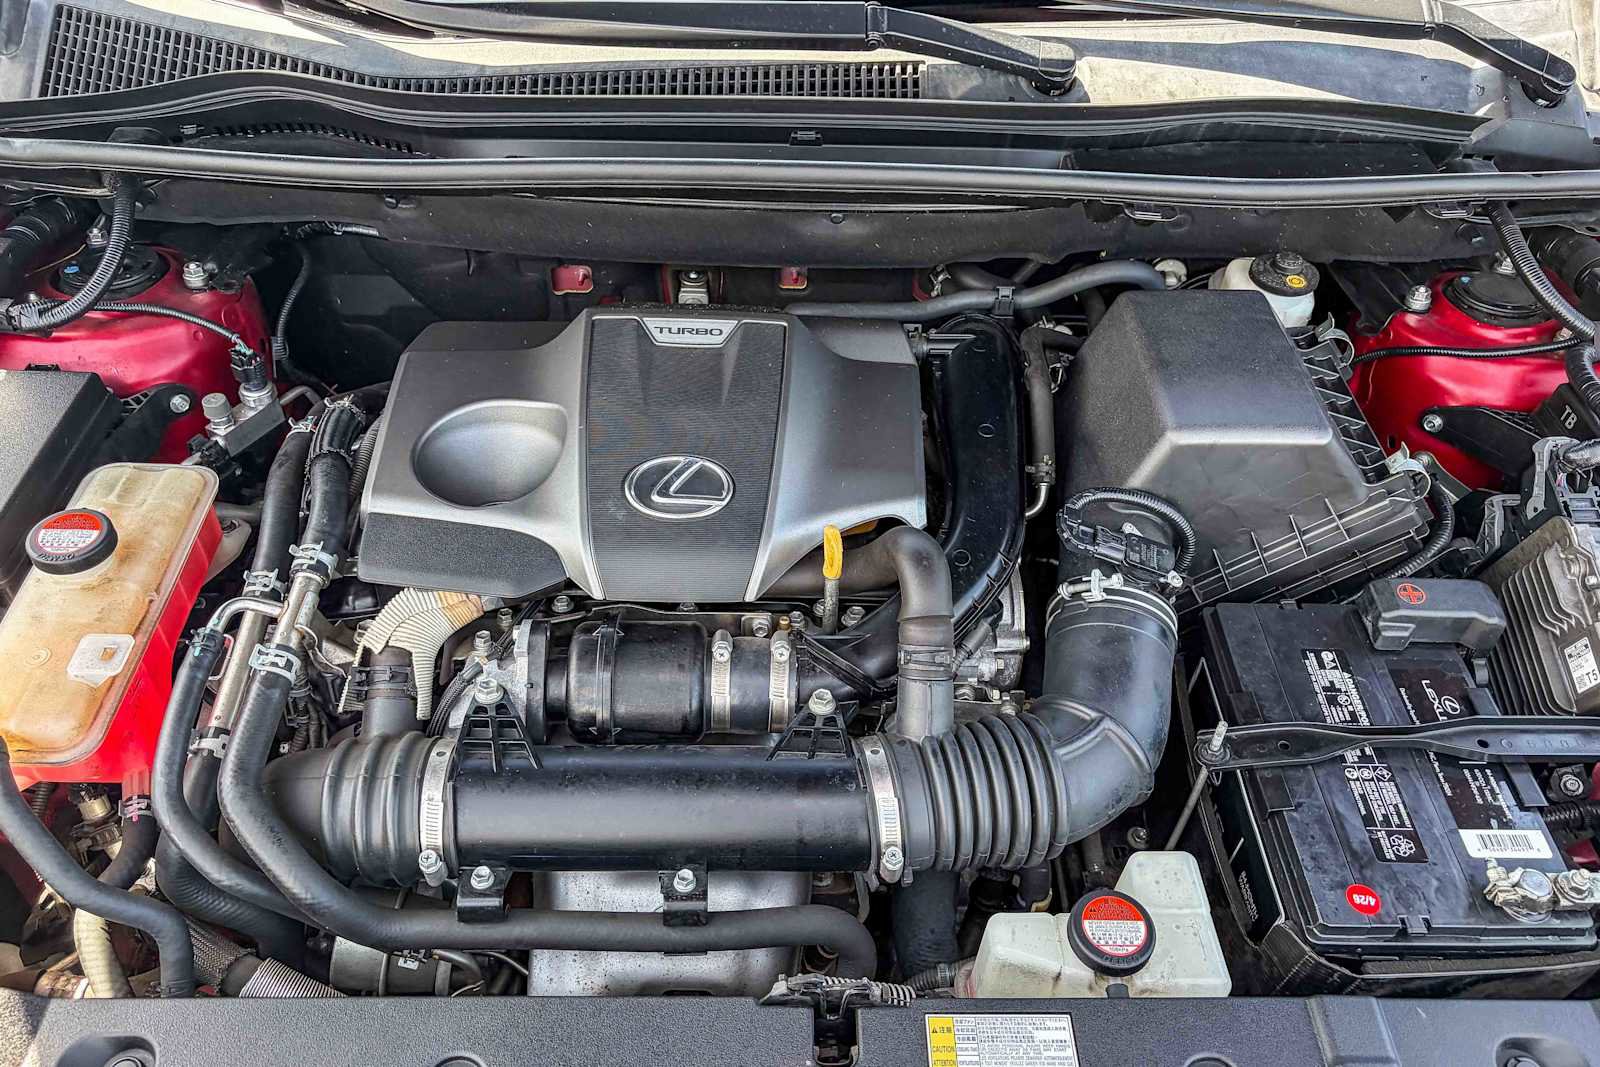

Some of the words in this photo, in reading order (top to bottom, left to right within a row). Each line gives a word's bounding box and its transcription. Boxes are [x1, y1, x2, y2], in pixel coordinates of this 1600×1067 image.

[654, 326, 723, 336] TURBO
[1561, 404, 1578, 430] TB
[1586, 669, 1599, 684] T5
[1421, 679, 1448, 722] LEXU
[932, 1045, 955, 1053] CAUTION
